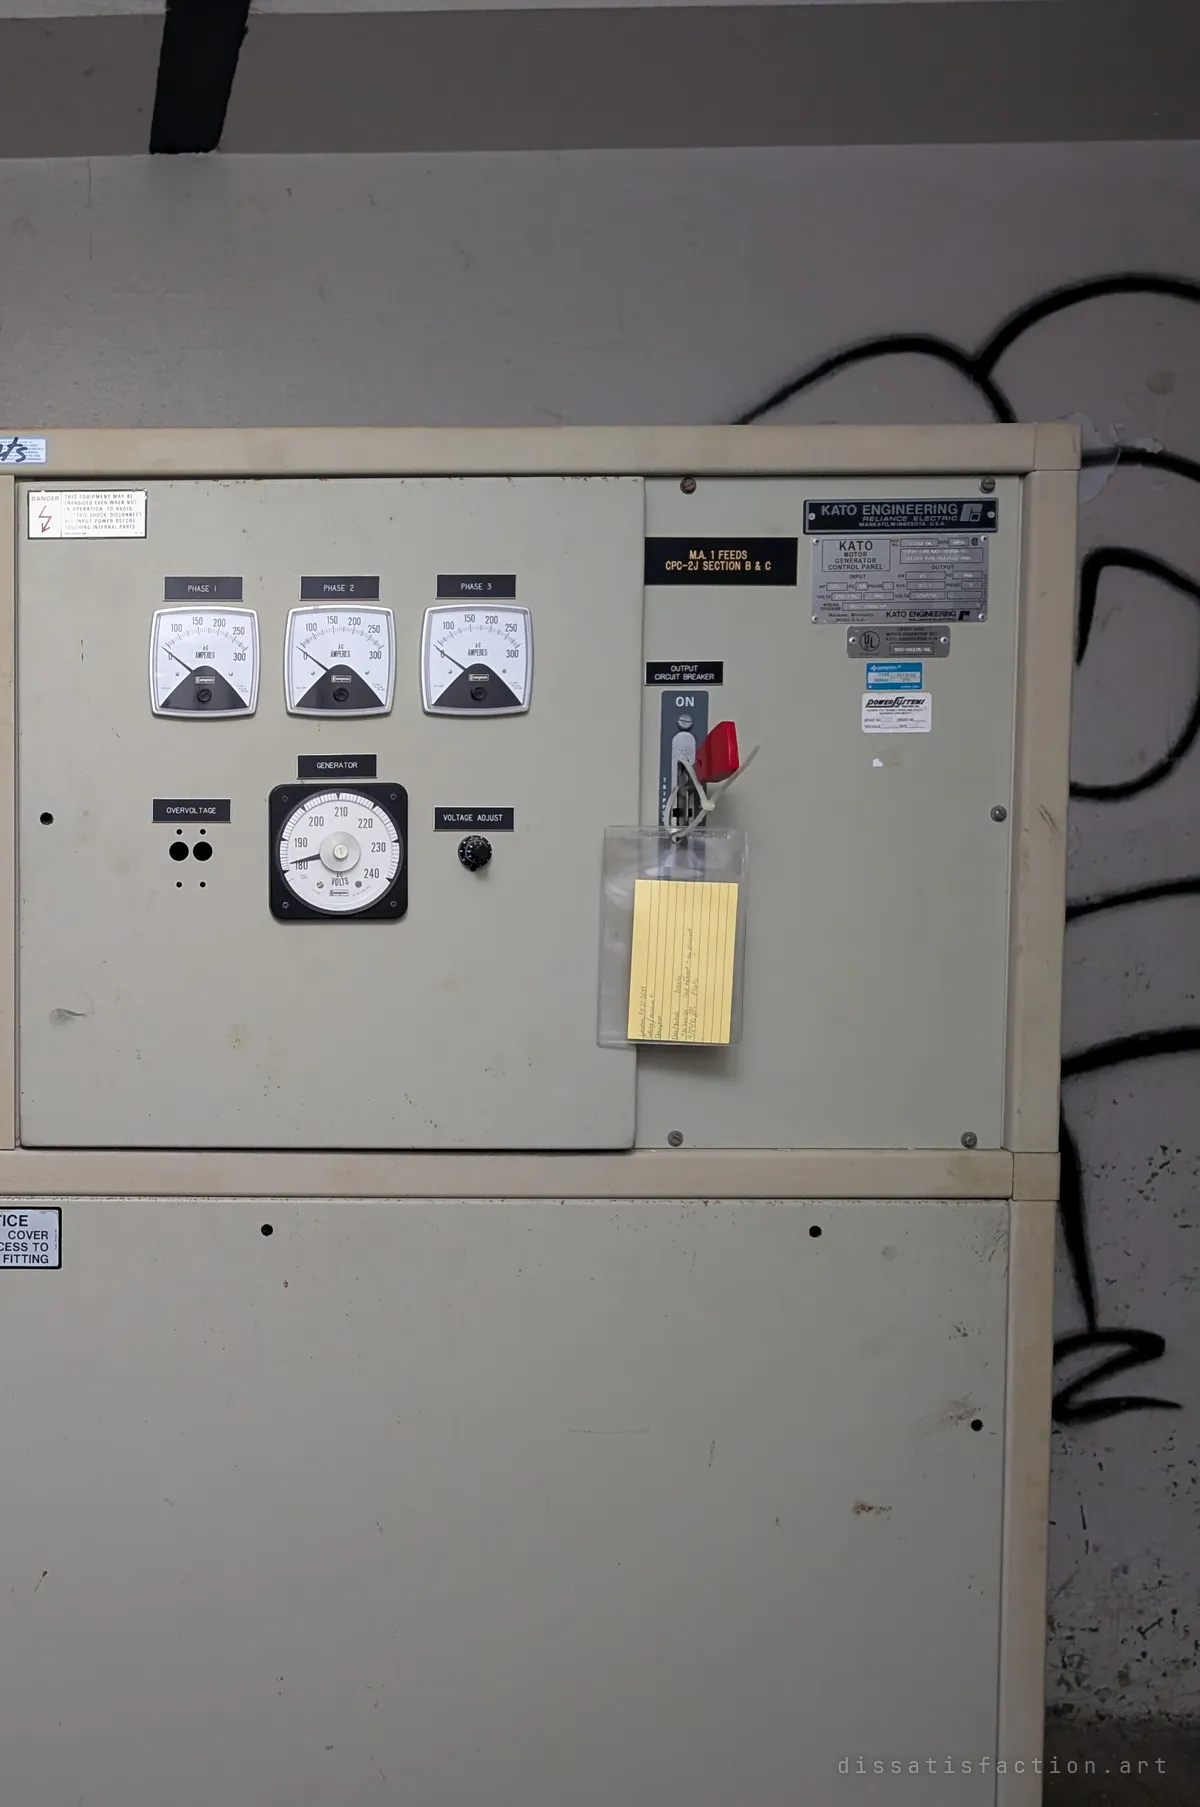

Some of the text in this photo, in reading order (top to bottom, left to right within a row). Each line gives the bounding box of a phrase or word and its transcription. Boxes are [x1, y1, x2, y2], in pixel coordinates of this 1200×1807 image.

[821, 503, 958, 516] KATO ENGINEERING
[839, 540, 873, 551] KATO
[710, 550, 714, 560] 1
[718, 550, 747, 560] FEEDS
[665, 561, 771, 571] CPC-2J SECTION B & C
[187, 585, 210, 593] PHASE
[323, 584, 355, 592] PHASE 2
[460, 582, 492, 590] PHASE 3
[192, 616, 203, 626] 150
[213, 618, 226, 628] 200
[327, 615, 338, 625] 150
[348, 617, 361, 626] 200
[464, 614, 476, 623] 150
[485, 615, 498, 624] 200
[170, 623, 183, 633] 100
[232, 626, 245, 635] 250
[305, 622, 317, 632] 100
[367, 625, 381, 634] 250
[443, 621, 455, 630] 100
[505, 623, 517, 632] 250
[195, 651, 215, 659] AMPERES
[233, 652, 246, 662] 300
[330, 650, 351, 658] AMPERES
[368, 650, 382, 660] 300
[506, 650, 519, 659] 300
[675, 697, 695, 707] ON
[166, 806, 217, 814] OVERVOLTAGE
[334, 806, 348, 817] 210
[308, 816, 324, 827] 200
[443, 813, 503, 822] VOLTAGE ADJUST
[358, 818, 373, 829] 220
[294, 837, 308, 848] 190
[371, 842, 386, 852] 230
[364, 868, 380, 878] 240
[331, 877, 349, 886] VOLTS
[7, 1230, 49, 1240] COVER
[32, 1242, 49, 1251] TO
[3, 1253, 49, 1264] FITTING
